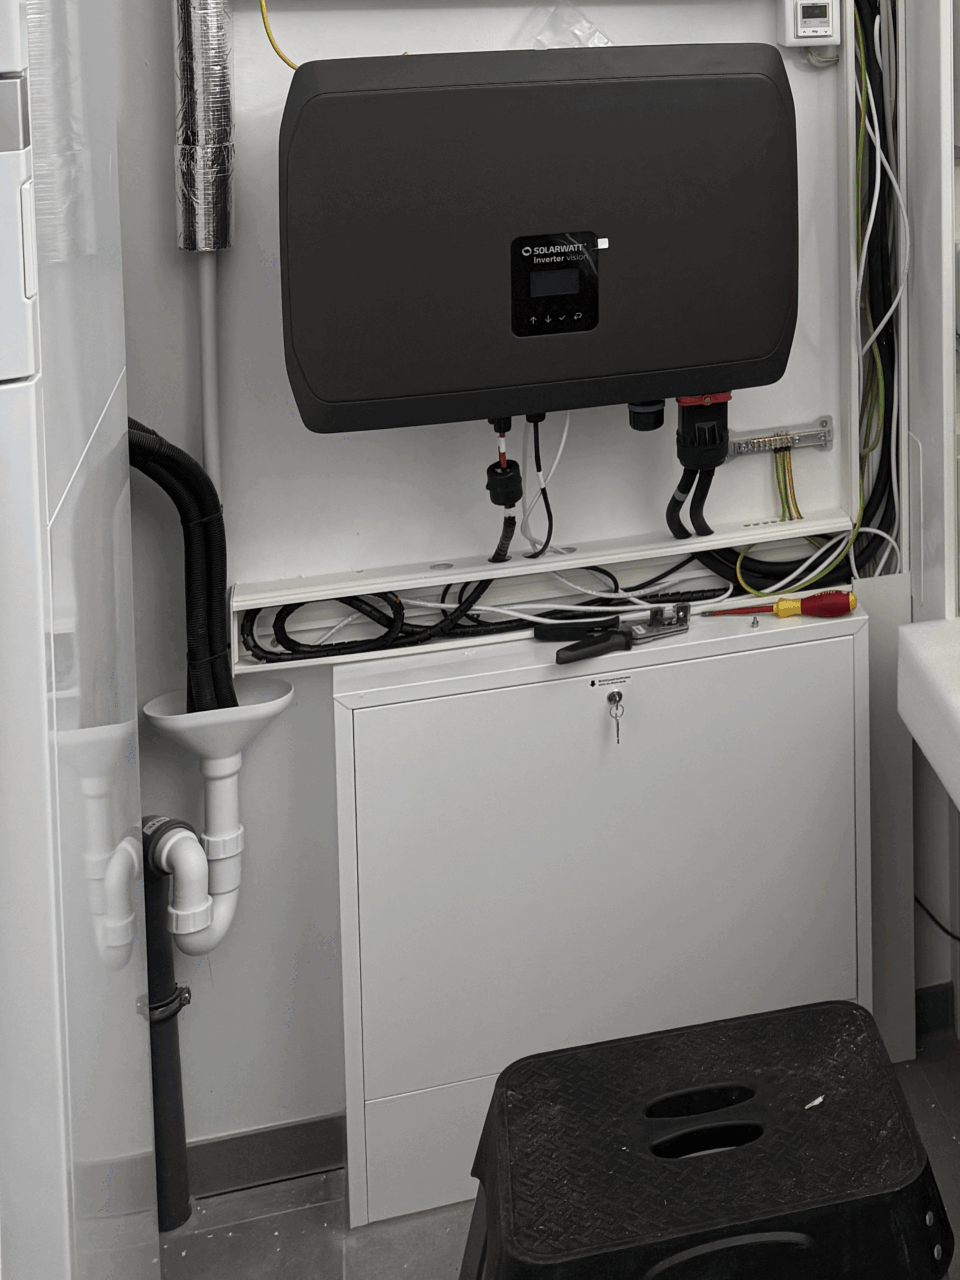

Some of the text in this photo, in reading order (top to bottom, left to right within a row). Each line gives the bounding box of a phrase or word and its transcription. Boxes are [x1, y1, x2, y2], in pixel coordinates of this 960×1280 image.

[533, 243, 584, 255] SOLARWATT
[533, 253, 589, 264] Inverter vision
